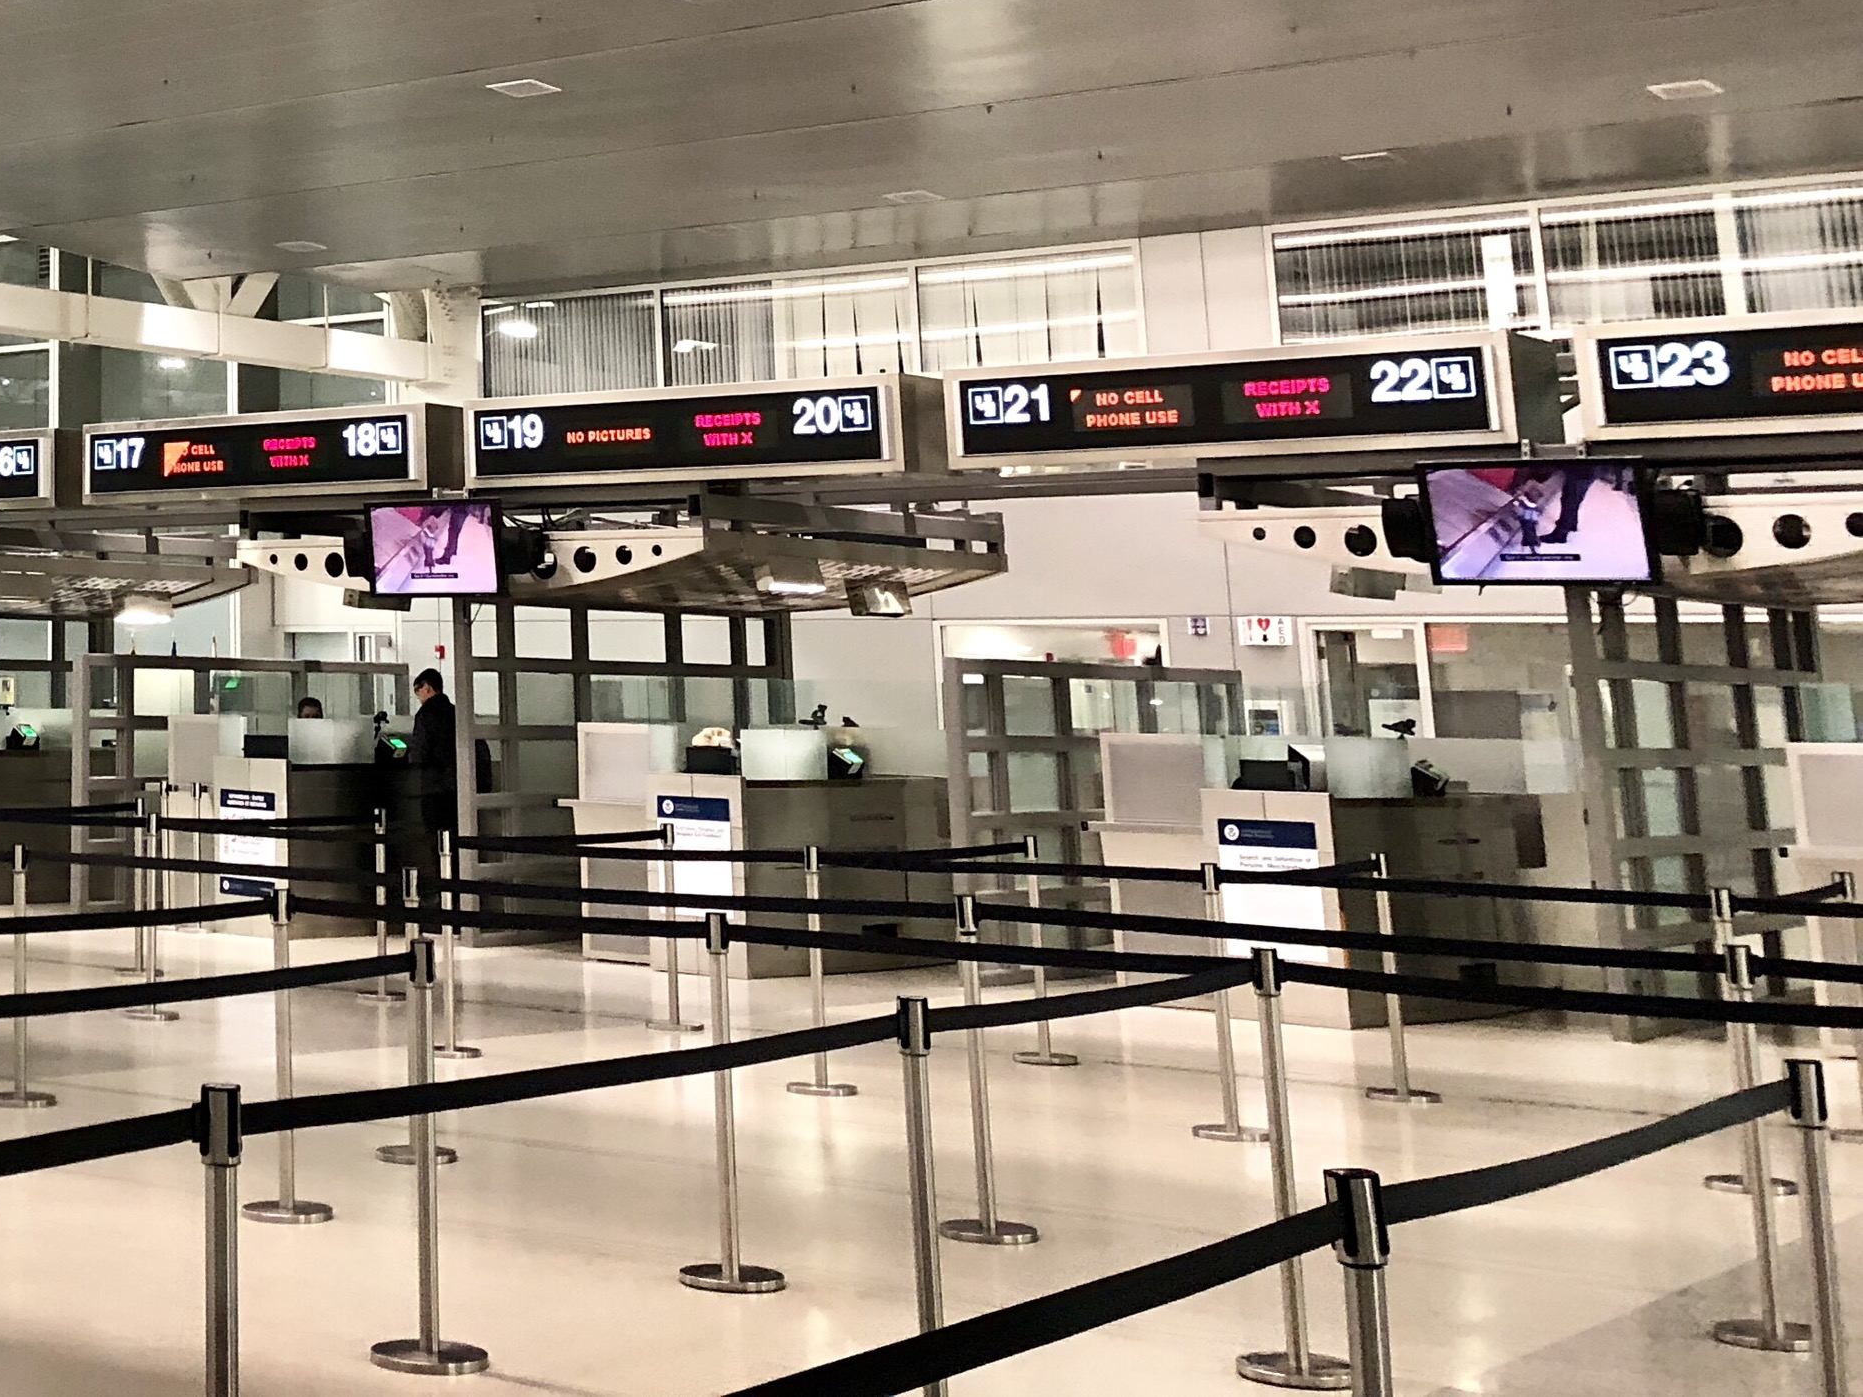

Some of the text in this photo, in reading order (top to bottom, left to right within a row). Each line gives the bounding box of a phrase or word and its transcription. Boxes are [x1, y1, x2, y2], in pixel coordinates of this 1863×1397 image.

[1657, 340, 1730, 388] 23
[1783, 350, 1816, 367] NO
[1243, 378, 1331, 396] RECEIPTS
[1370, 358, 1431, 402] 22
[1771, 372, 1848, 392] PHONE
[1004, 384, 1050, 423] 21
[1095, 390, 1164, 407] NO CELL
[793, 397, 837, 434] 20
[1085, 409, 1179, 428] PHONE USE
[1255, 399, 1320, 419] WITH X
[694, 412, 762, 428] RECEIPTS
[343, 423, 376, 456] 18
[509, 414, 544, 448] 19
[567, 428, 651, 444] NO PICTURES
[703, 431, 754, 447] WITH X
[116, 438, 145, 468] 17
[191, 444, 216, 456] CELL
[169, 460, 200, 473] HONE
